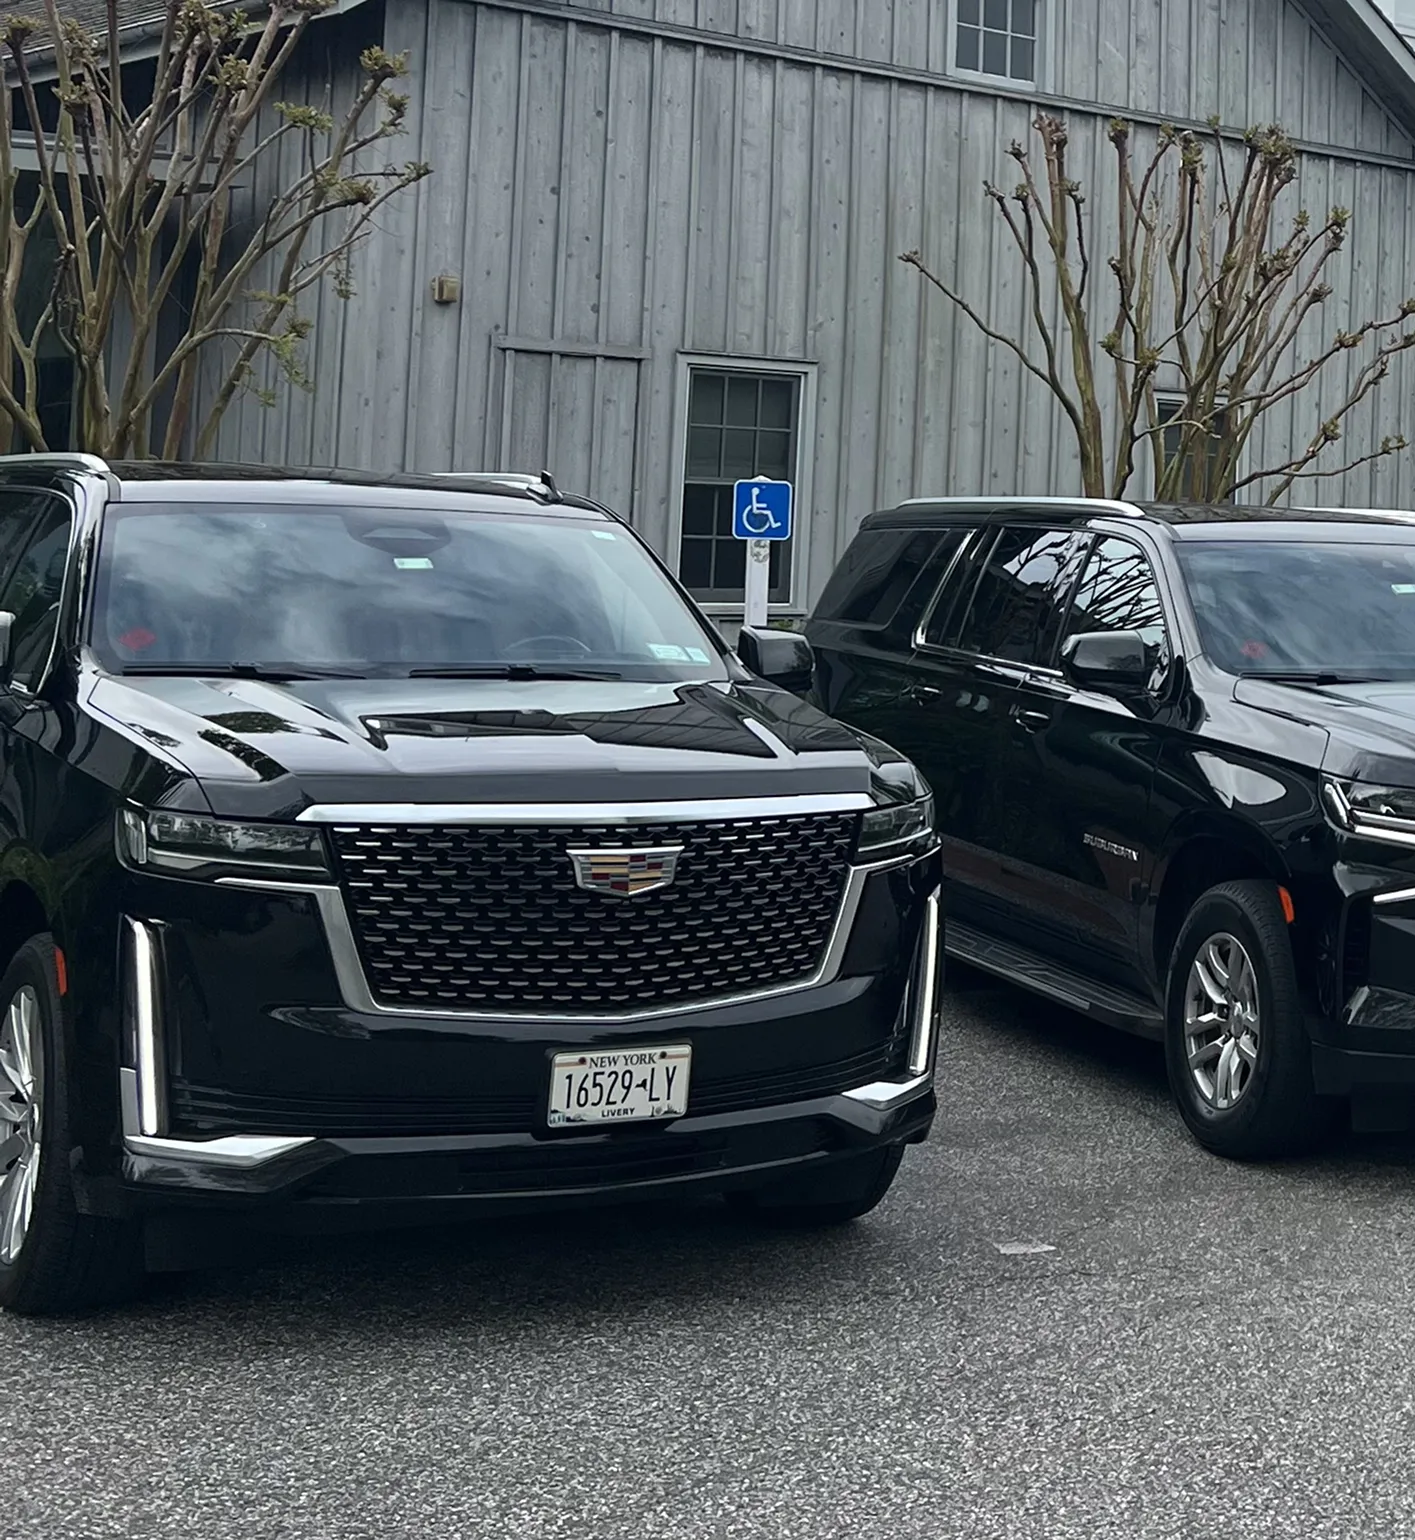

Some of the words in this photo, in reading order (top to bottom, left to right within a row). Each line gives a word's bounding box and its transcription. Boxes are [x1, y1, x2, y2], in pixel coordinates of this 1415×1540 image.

[589, 1055, 620, 1069] NEW
[623, 1052, 658, 1066] YORK
[601, 1107, 636, 1118] LIVERY
